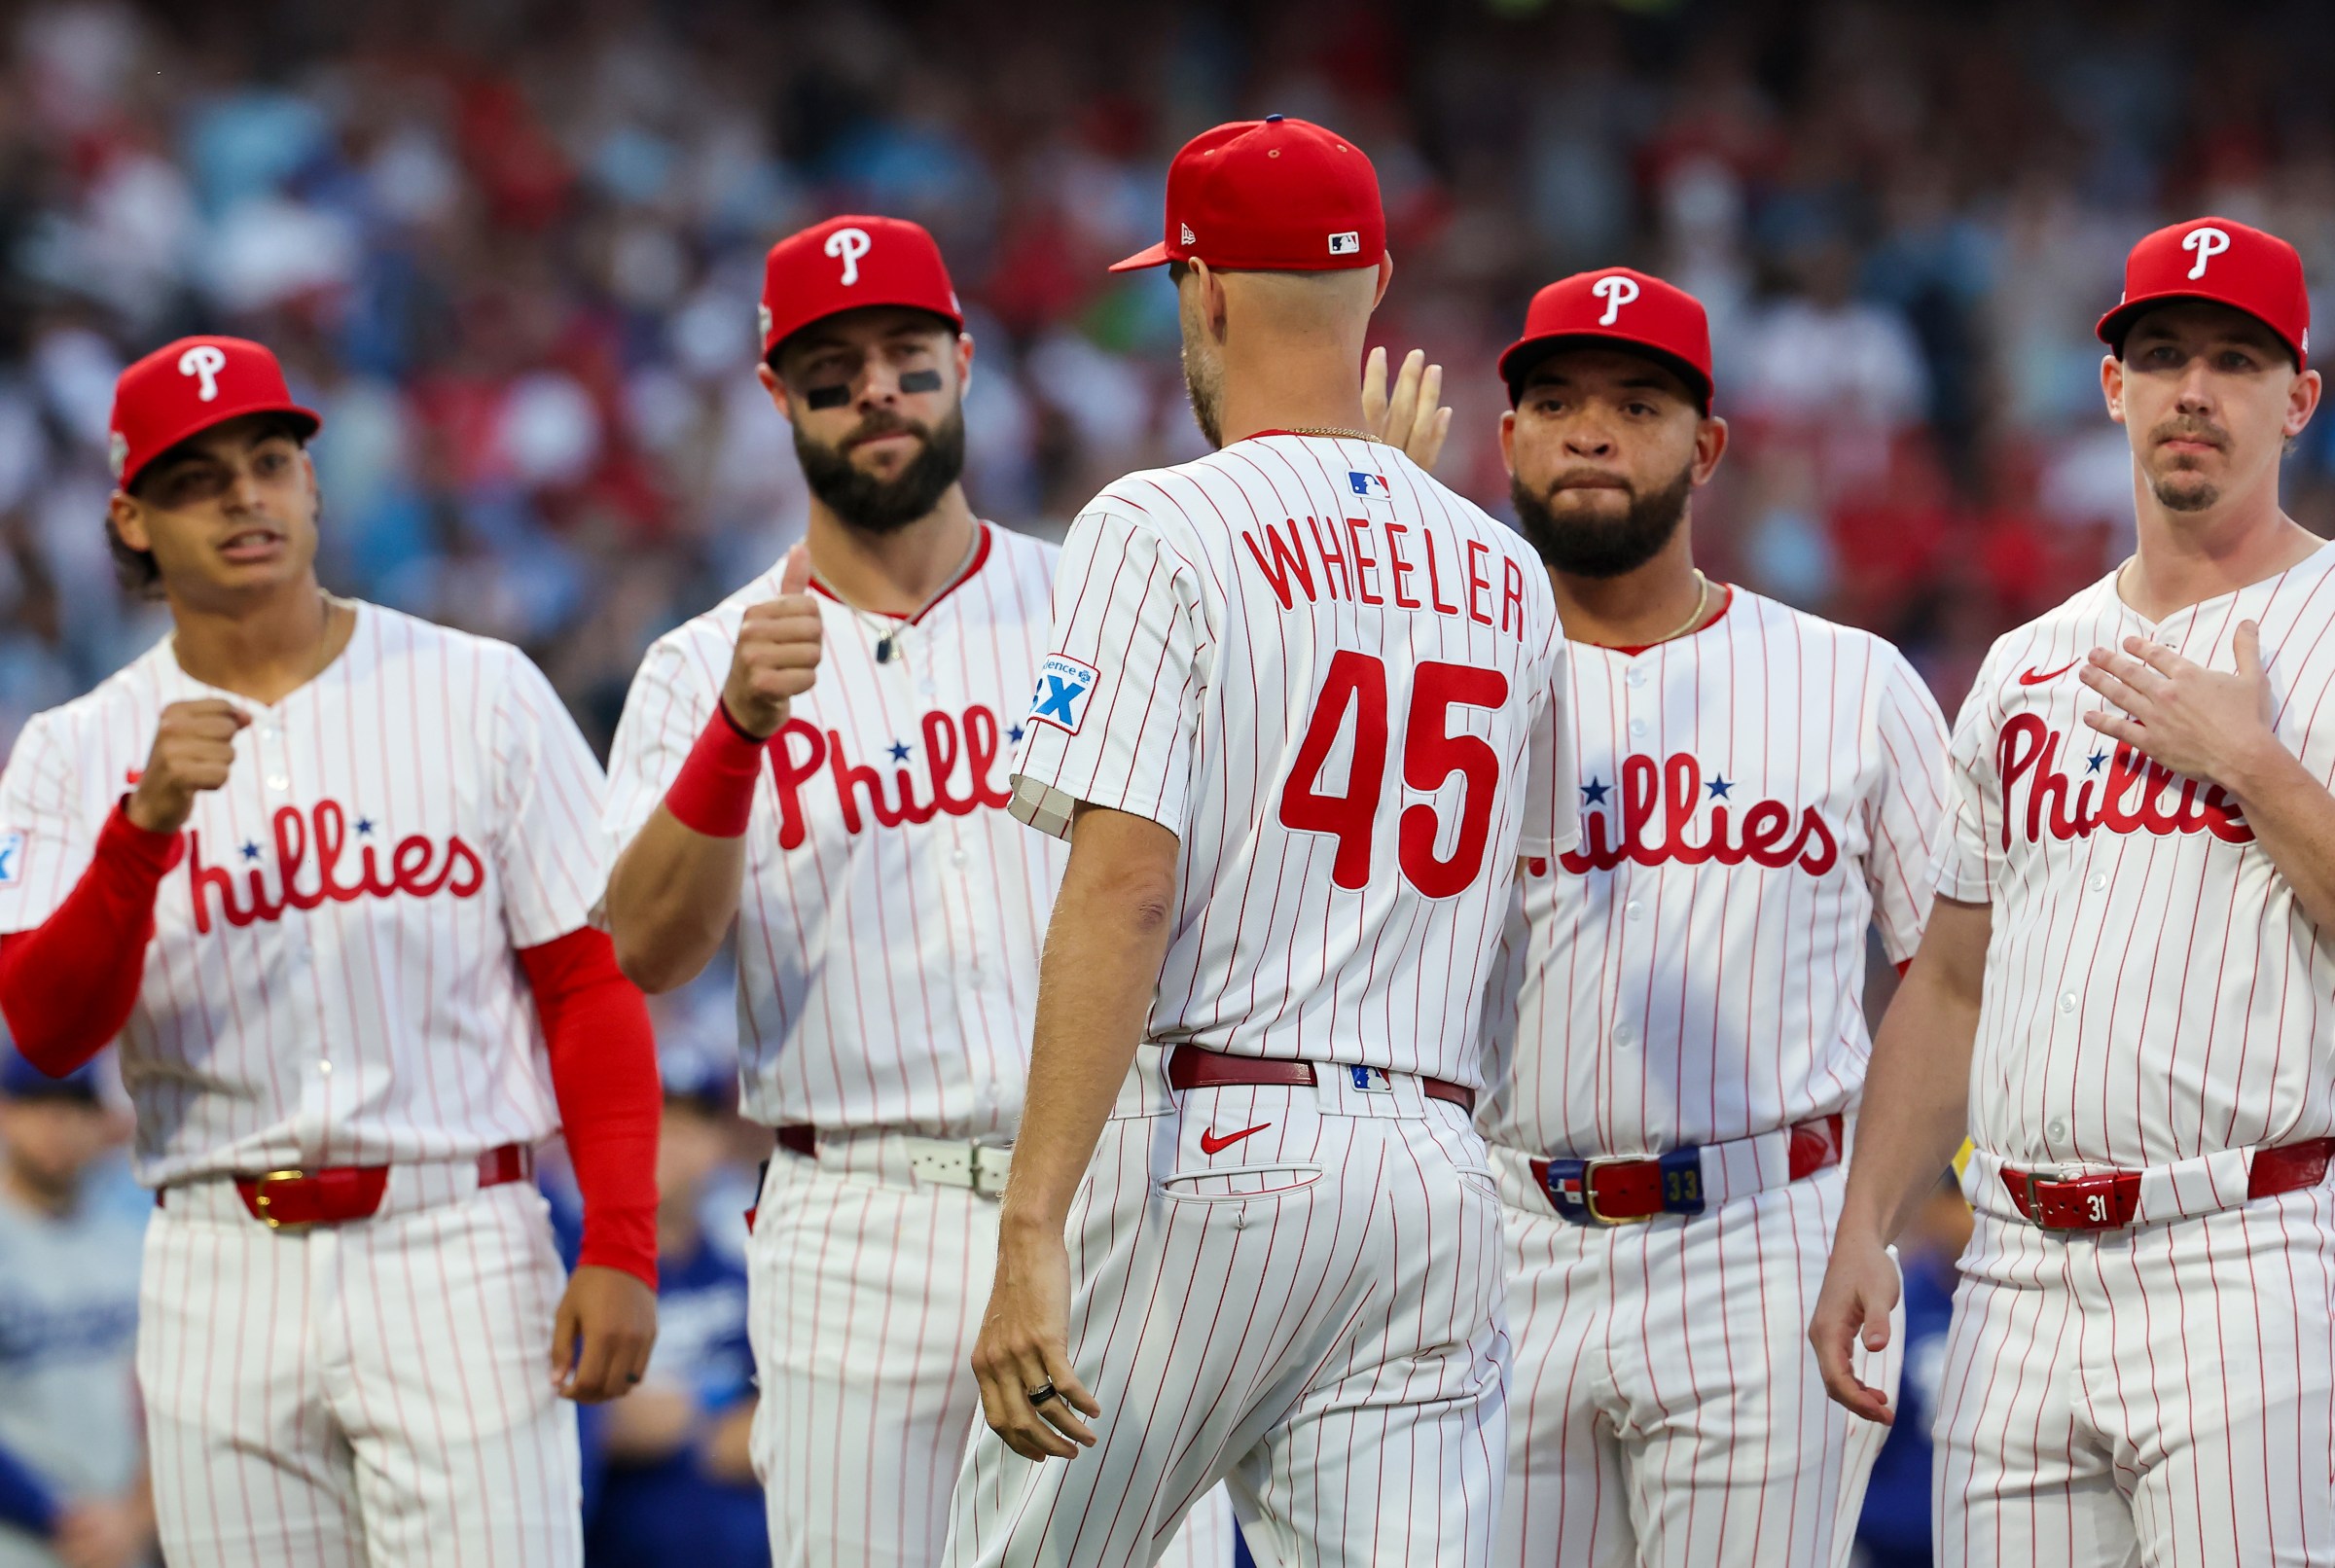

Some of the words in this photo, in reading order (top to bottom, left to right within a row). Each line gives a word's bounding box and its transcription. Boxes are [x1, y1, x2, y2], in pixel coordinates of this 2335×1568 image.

[824, 228, 872, 286] P
[2181, 227, 2231, 280] P
[1592, 275, 1640, 327] P
[178, 345, 227, 402] P
[1241, 516, 1525, 643] WHEELER
[765, 704, 1016, 850] Phill
[1278, 649, 1509, 900] 45
[1528, 752, 1838, 876] illies
[1996, 712, 2258, 855] Phillie
[175, 799, 485, 935] hillies
[1668, 1169, 1699, 1201] 33
[2087, 1194, 2107, 1222] 31
